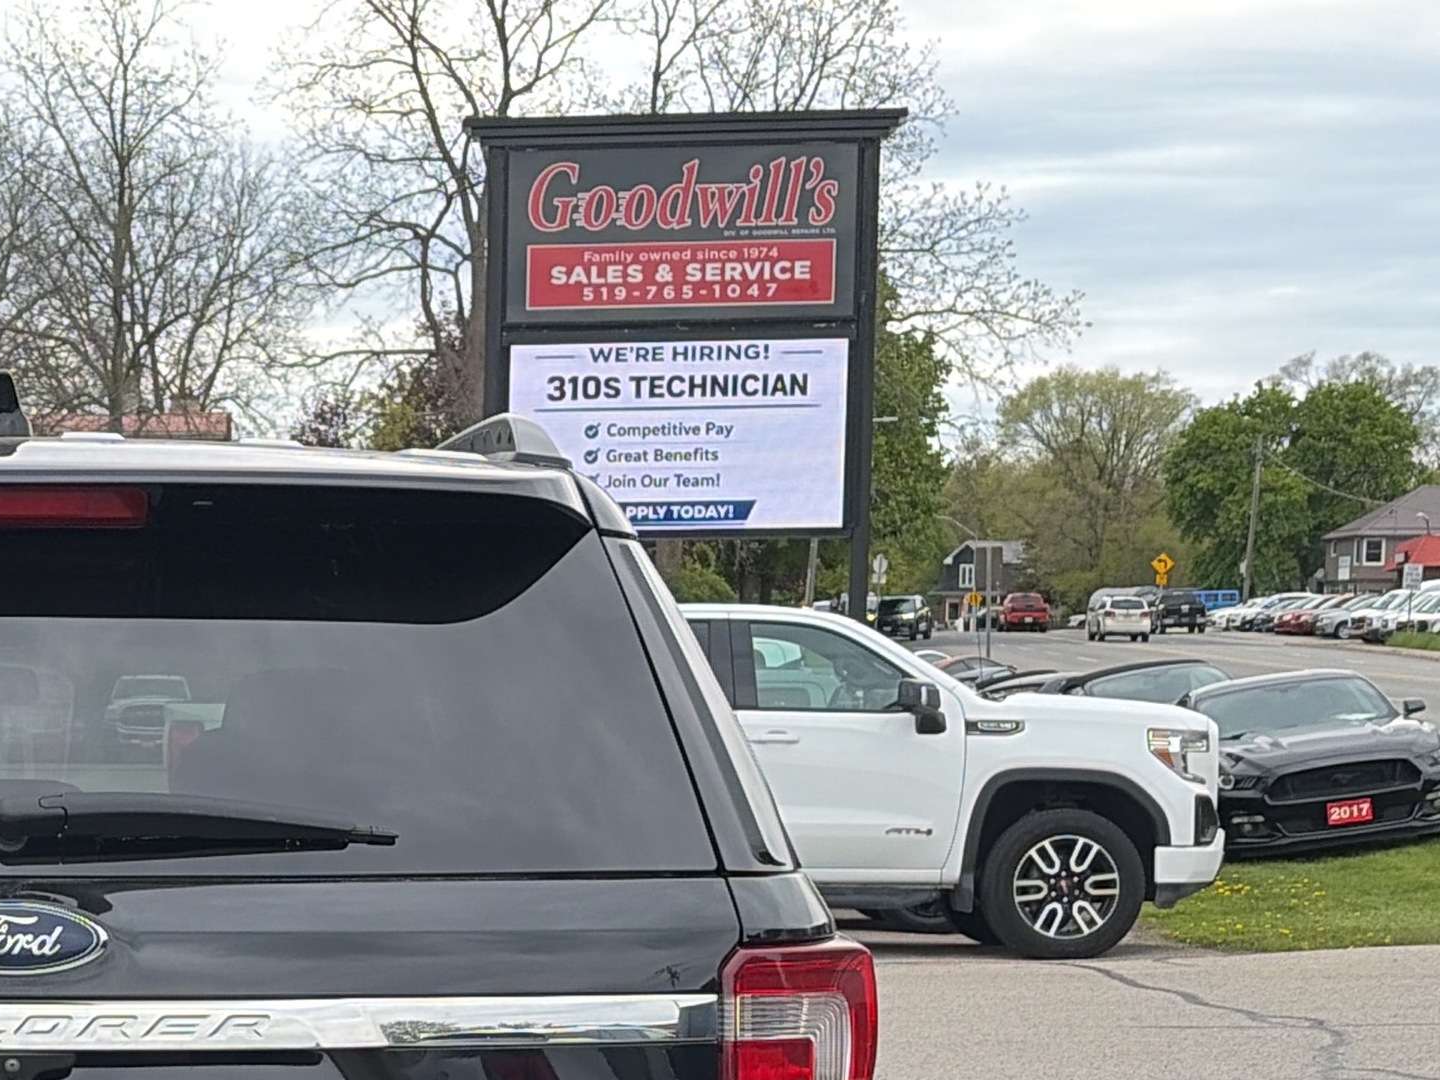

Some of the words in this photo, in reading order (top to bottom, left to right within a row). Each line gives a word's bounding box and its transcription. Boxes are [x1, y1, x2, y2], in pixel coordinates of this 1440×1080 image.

[528, 157, 839, 232] Goodwill's
[583, 249, 634, 263] Family
[639, 249, 692, 262] owned
[696, 247, 738, 260] since
[743, 246, 779, 259] 1974
[550, 263, 644, 285] SALES
[654, 263, 674, 283] &
[684, 260, 812, 281] SERVICE
[582, 283, 779, 302] 519-765-1047
[589, 346, 665, 363] WE'RE
[671, 343, 771, 361] HIRING!
[546, 375, 622, 401] 310S
[628, 373, 809, 399] TECHNICIAN
[606, 421, 702, 440] Competitive
[705, 421, 735, 439] Pay
[606, 449, 649, 464] Great
[653, 446, 720, 463] Benefits
[603, 474, 637, 490] Join
[640, 473, 670, 488] Our
[673, 472, 721, 488] Team!
[624, 504, 667, 521] PPLY
[669, 503, 735, 520] TODAY!
[1329, 802, 1370, 821] 2017
